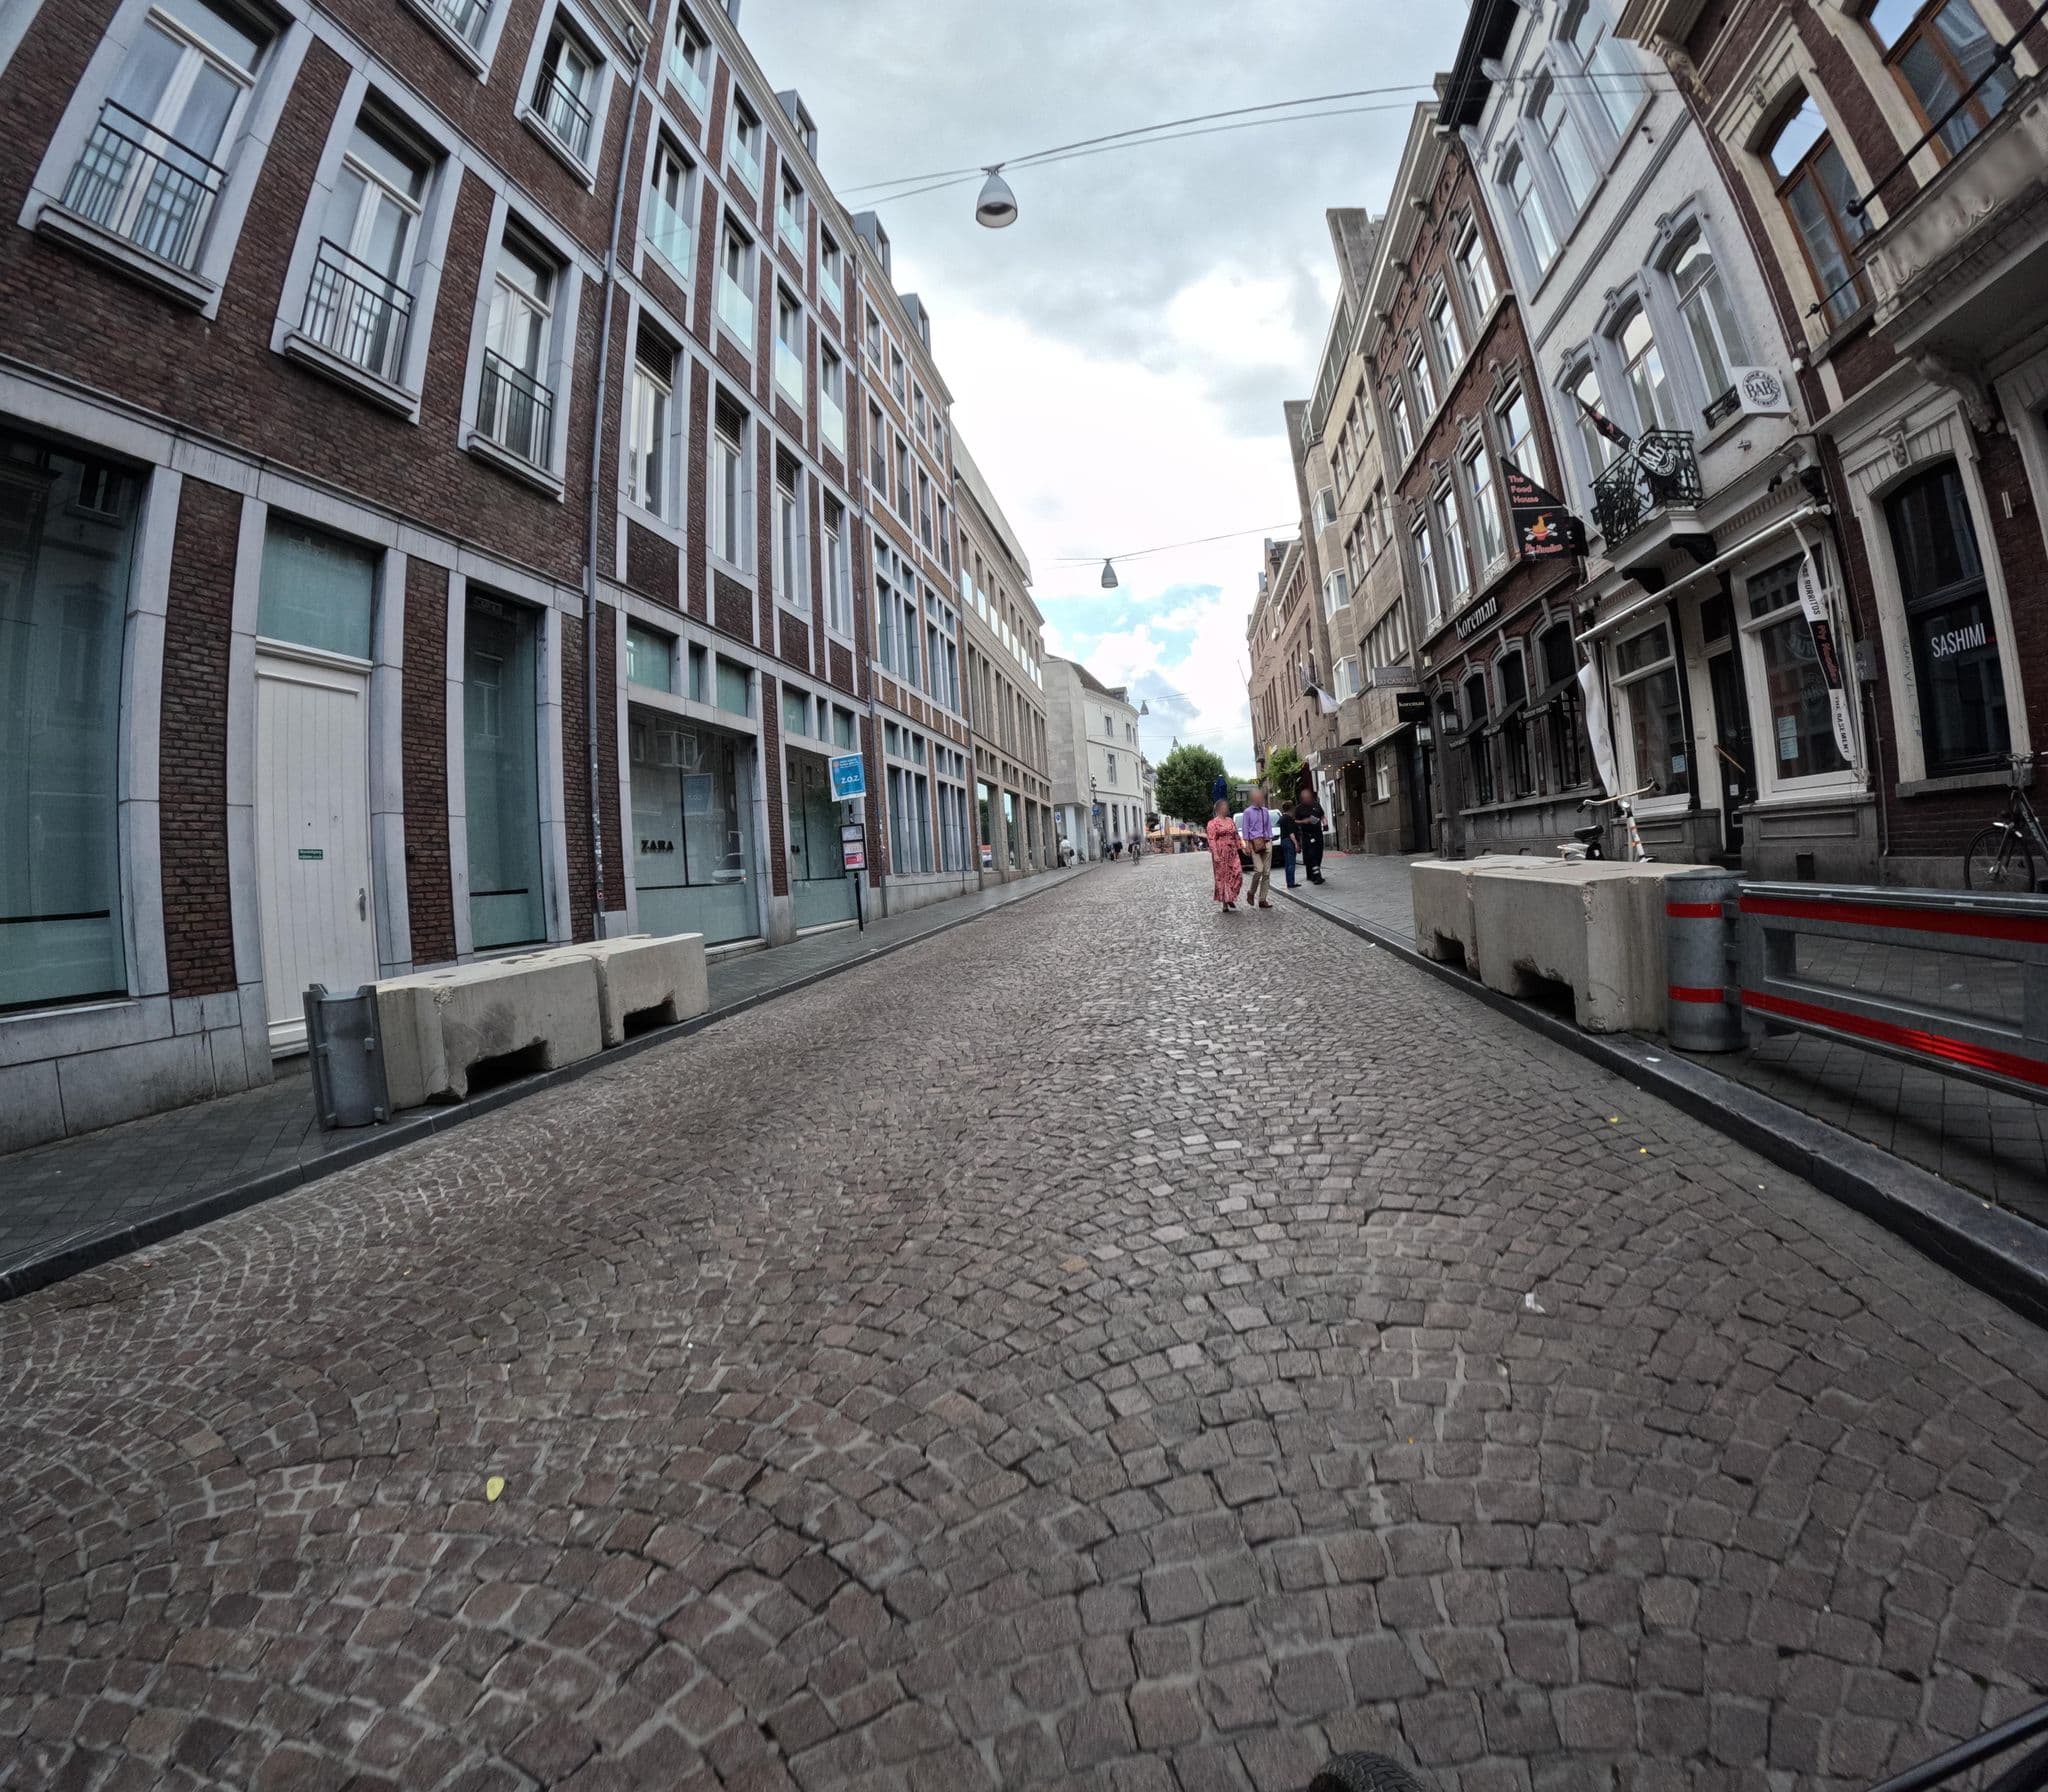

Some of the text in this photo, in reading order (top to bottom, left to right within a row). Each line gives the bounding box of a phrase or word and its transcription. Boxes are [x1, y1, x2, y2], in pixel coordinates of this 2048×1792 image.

[1511, 485, 1532, 494] Food
[1513, 496, 1539, 504] House
[1804, 580, 1820, 615] BURRITOS
[1455, 597, 1497, 640] Koreman
[1931, 623, 1986, 657] SASHIMI
[1837, 713, 1849, 753] BASEMENT
[641, 839, 673, 851] ZARA
